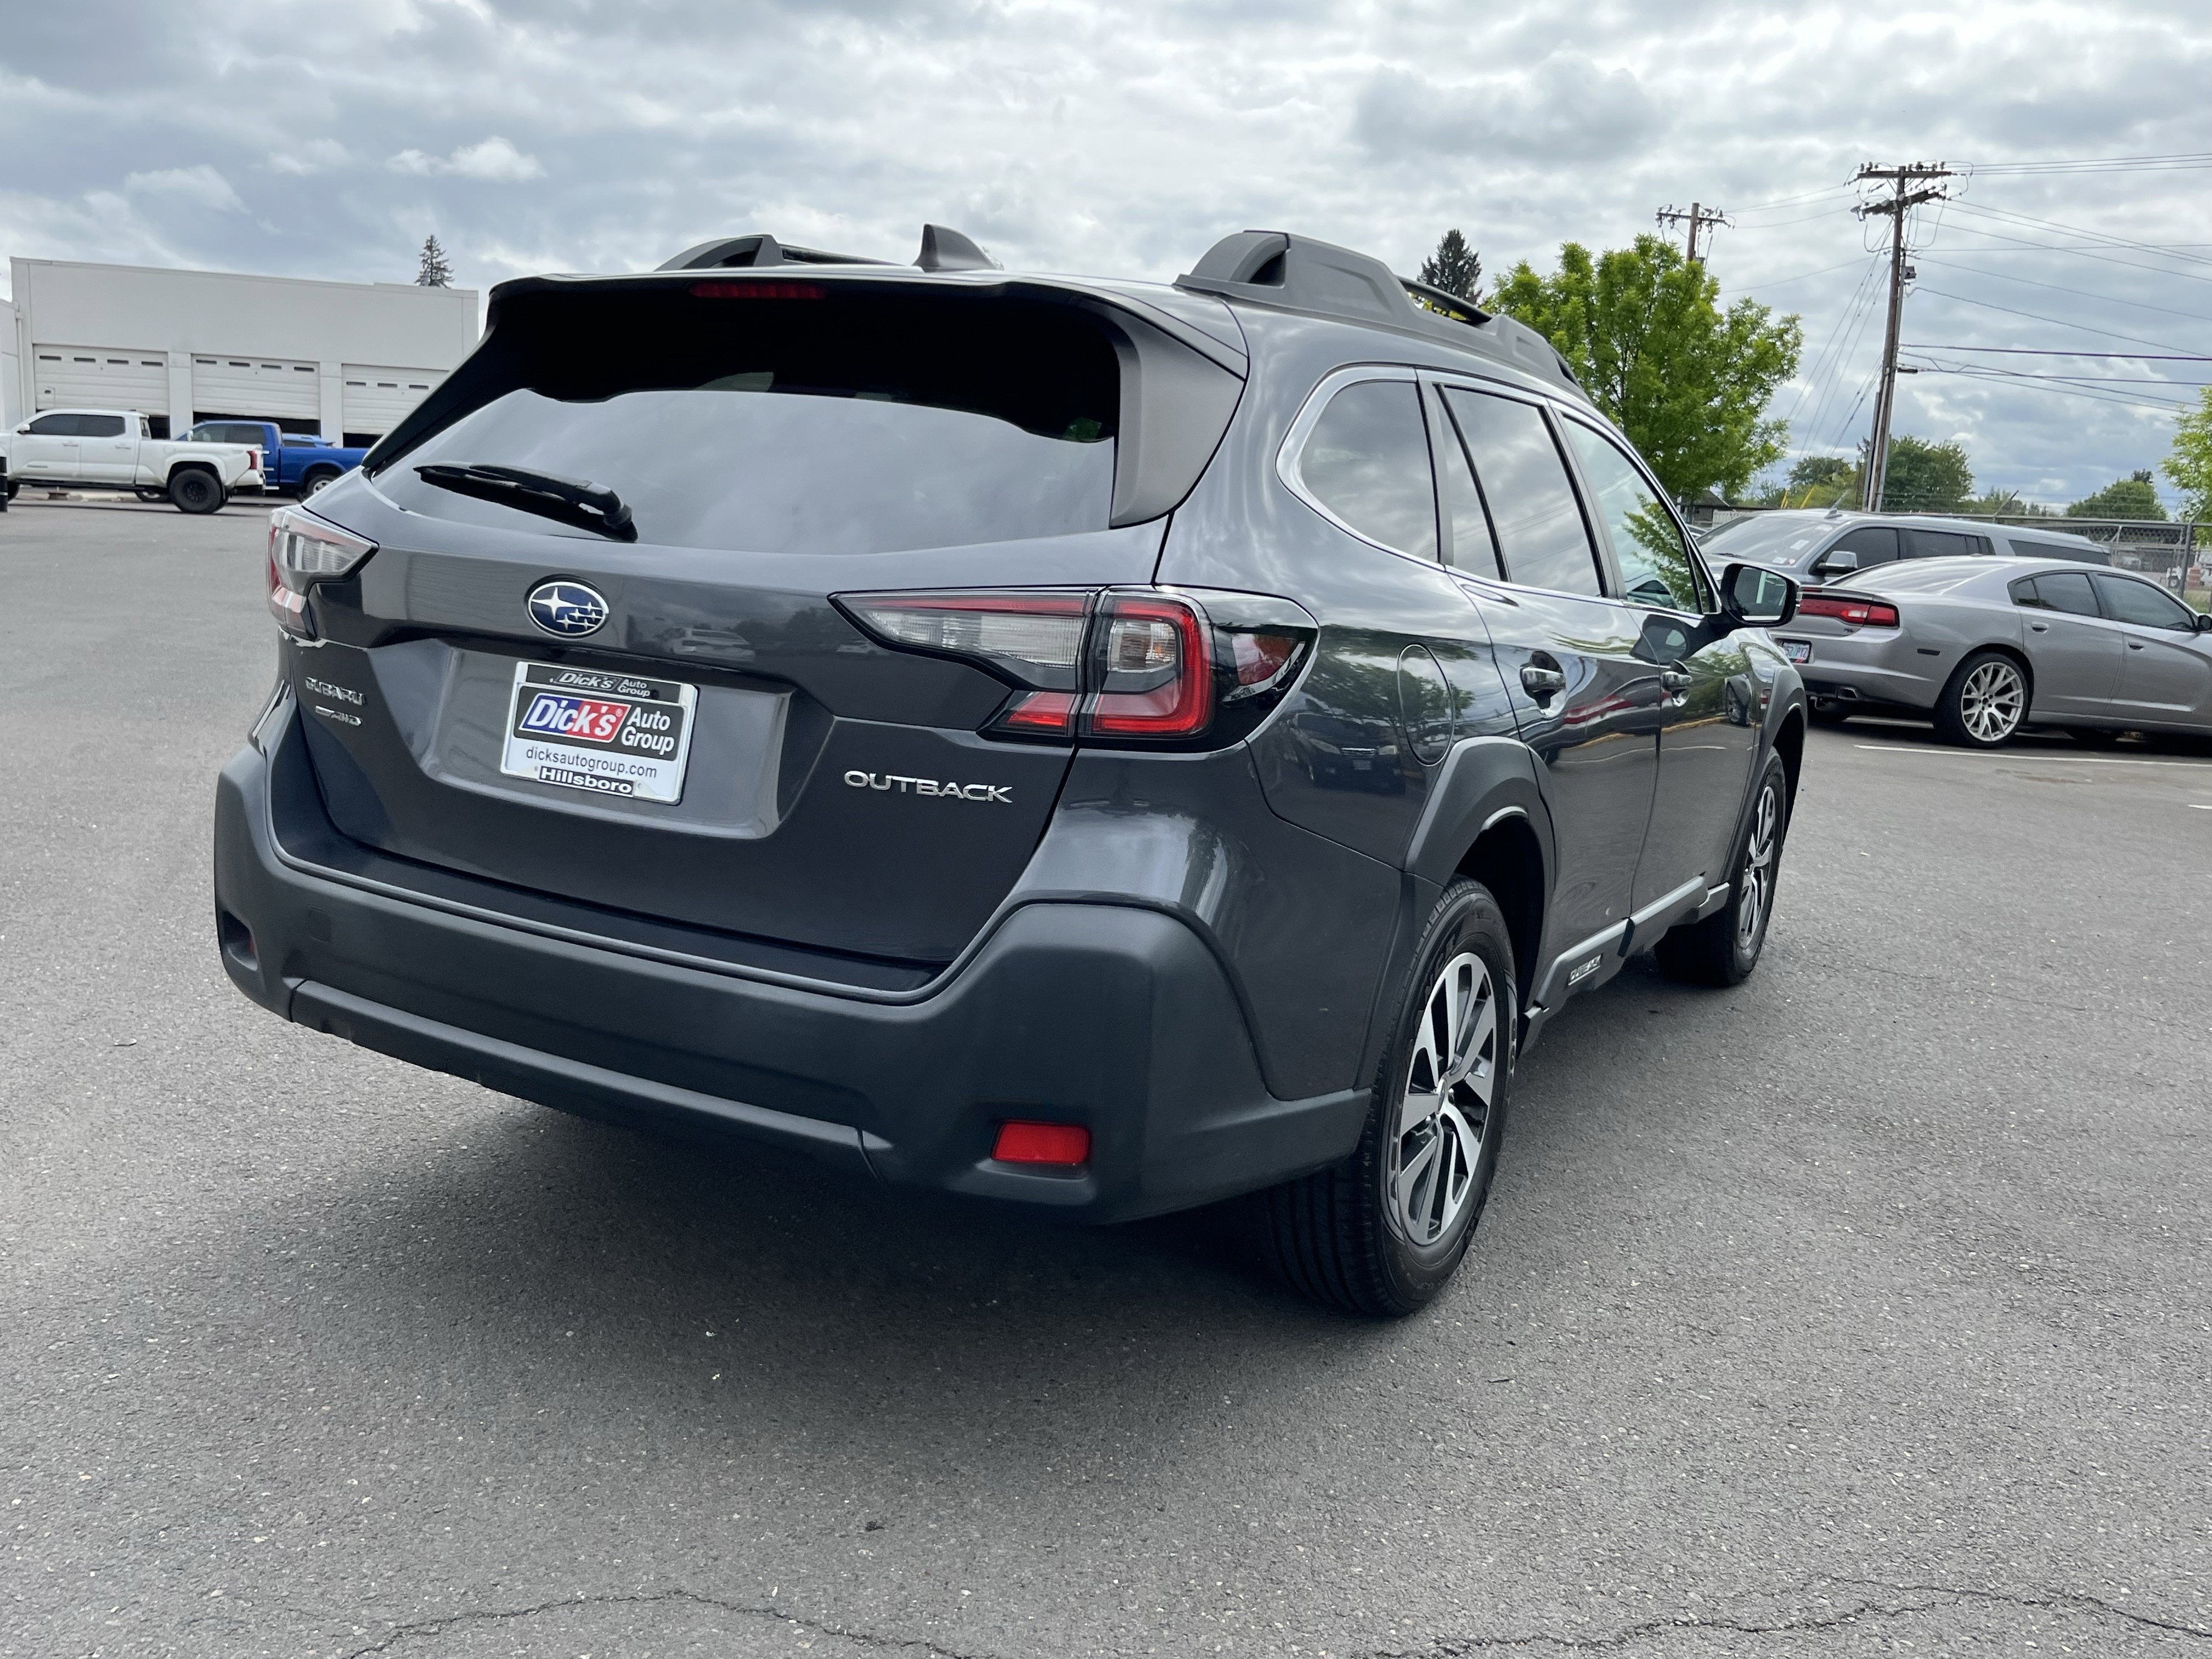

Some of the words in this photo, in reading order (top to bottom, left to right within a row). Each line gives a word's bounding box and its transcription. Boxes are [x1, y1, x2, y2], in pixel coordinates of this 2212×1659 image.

[305, 676, 366, 706] SUBARU
[558, 672, 614, 689] Dick's
[622, 679, 648, 689] Auto
[617, 685, 651, 697] Group
[527, 698, 617, 737] Dick's
[627, 707, 670, 731] Auto
[621, 726, 675, 755] Group
[526, 746, 657, 779] dicksautogroup.com
[540, 766, 633, 794] Hillsboro
[844, 770, 1013, 803] OUTBACK
